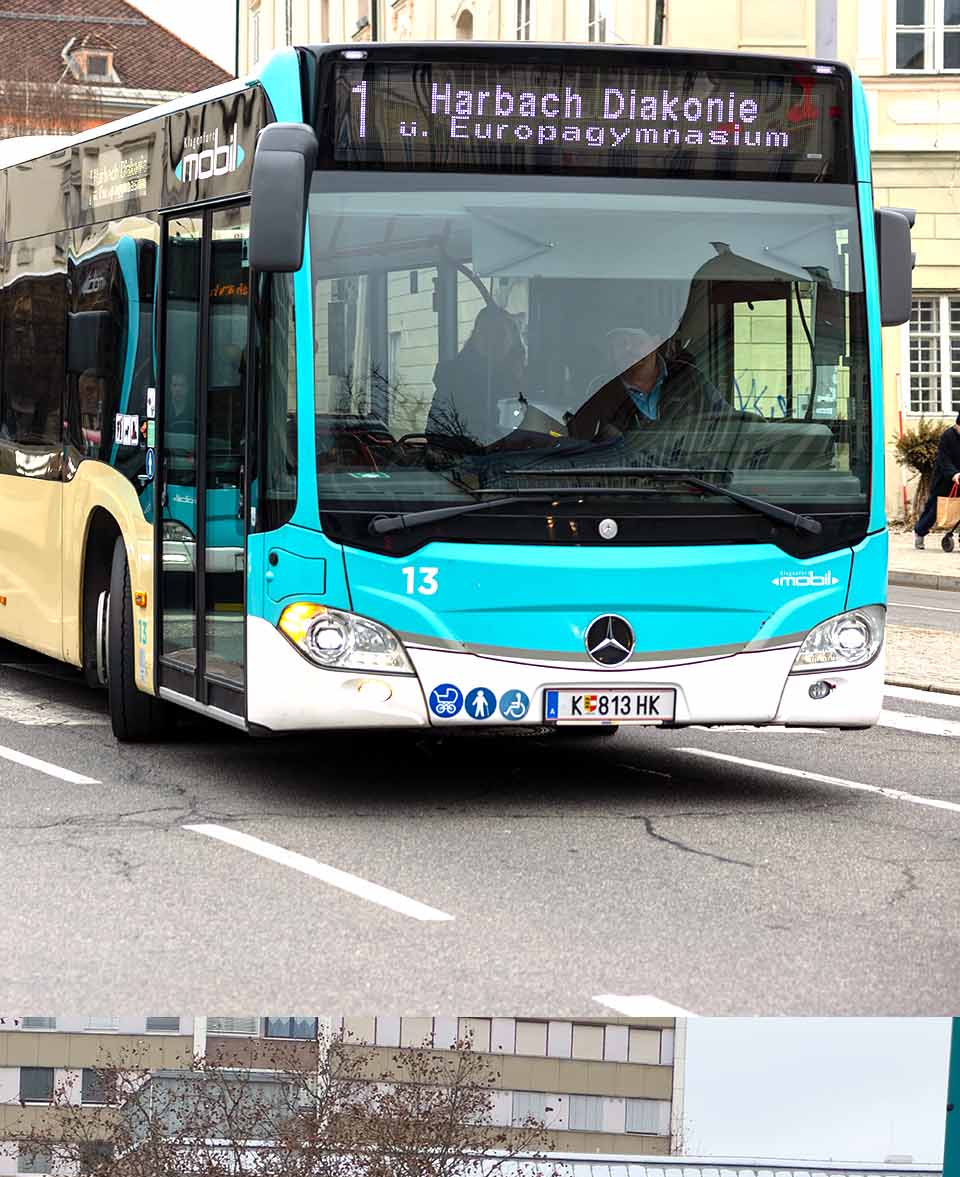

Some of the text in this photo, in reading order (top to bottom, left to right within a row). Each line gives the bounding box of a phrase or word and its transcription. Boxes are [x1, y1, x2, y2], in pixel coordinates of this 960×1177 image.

[351, 80, 367, 138] 1
[431, 82, 758, 123] Harbach Diakonie
[450, 115, 789, 147] Europagymnasium
[182, 122, 238, 183] mobil
[402, 566, 439, 595] 13
[780, 570, 831, 586] mobil
[571, 695, 660, 716] K 813 HK
